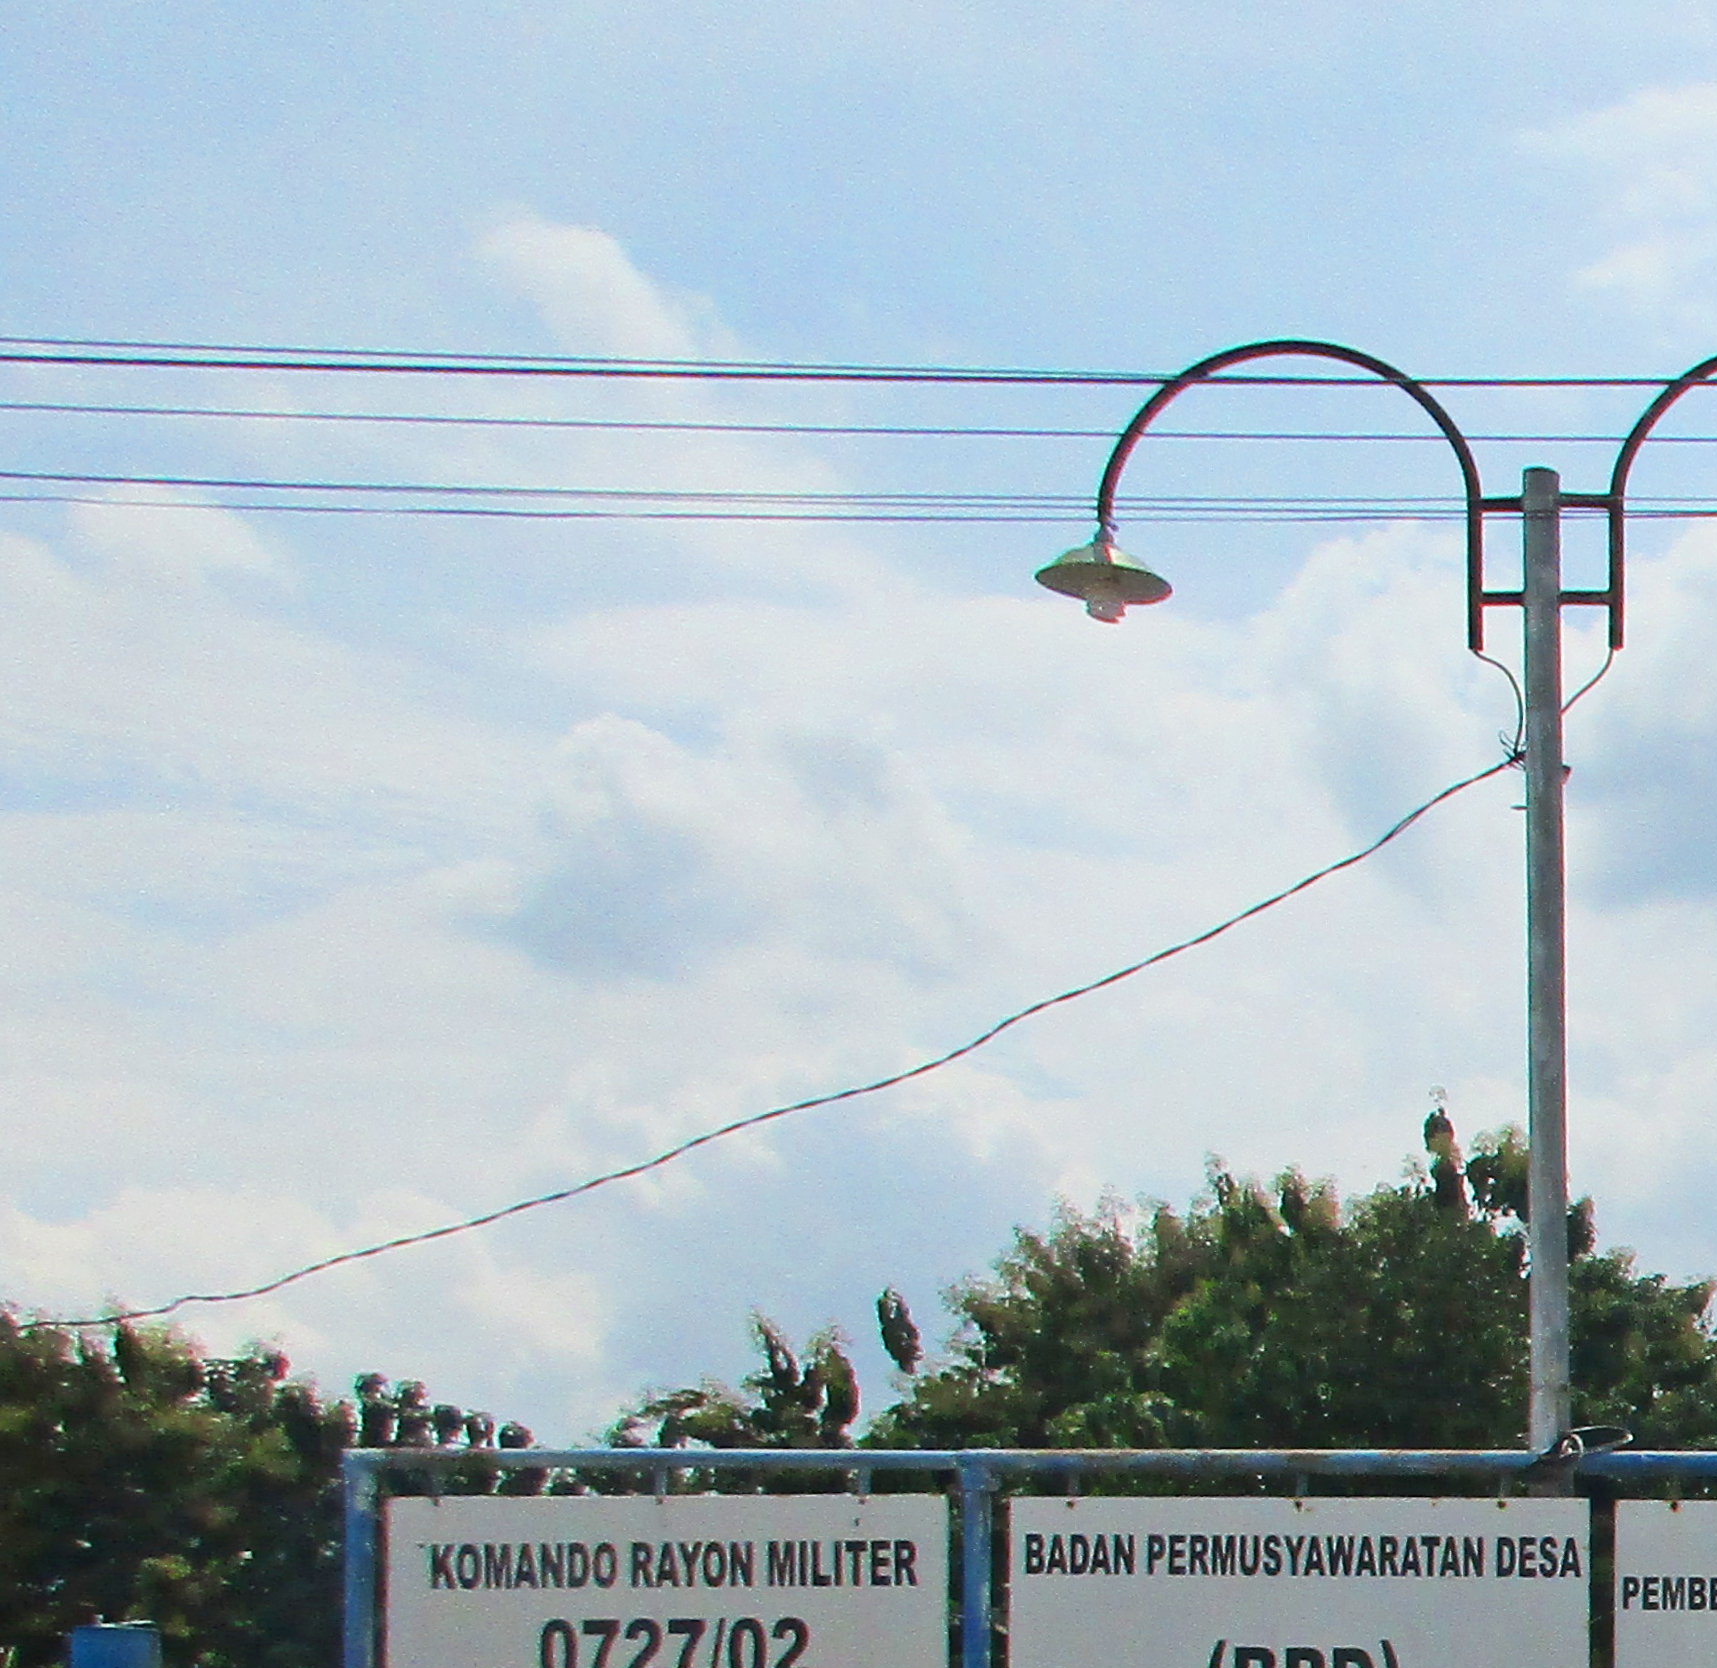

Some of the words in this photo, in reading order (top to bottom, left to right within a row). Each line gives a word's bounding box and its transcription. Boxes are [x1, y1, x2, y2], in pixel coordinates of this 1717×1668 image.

[429, 1541, 618, 1590] KOMANDO
[630, 1540, 754, 1589] RAYON
[766, 1539, 918, 1588] MILITER
[1024, 1533, 1135, 1576] BADAN
[1146, 1533, 1485, 1578] PERMUSYAWARATAN
[1495, 1536, 1582, 1579] DESA
